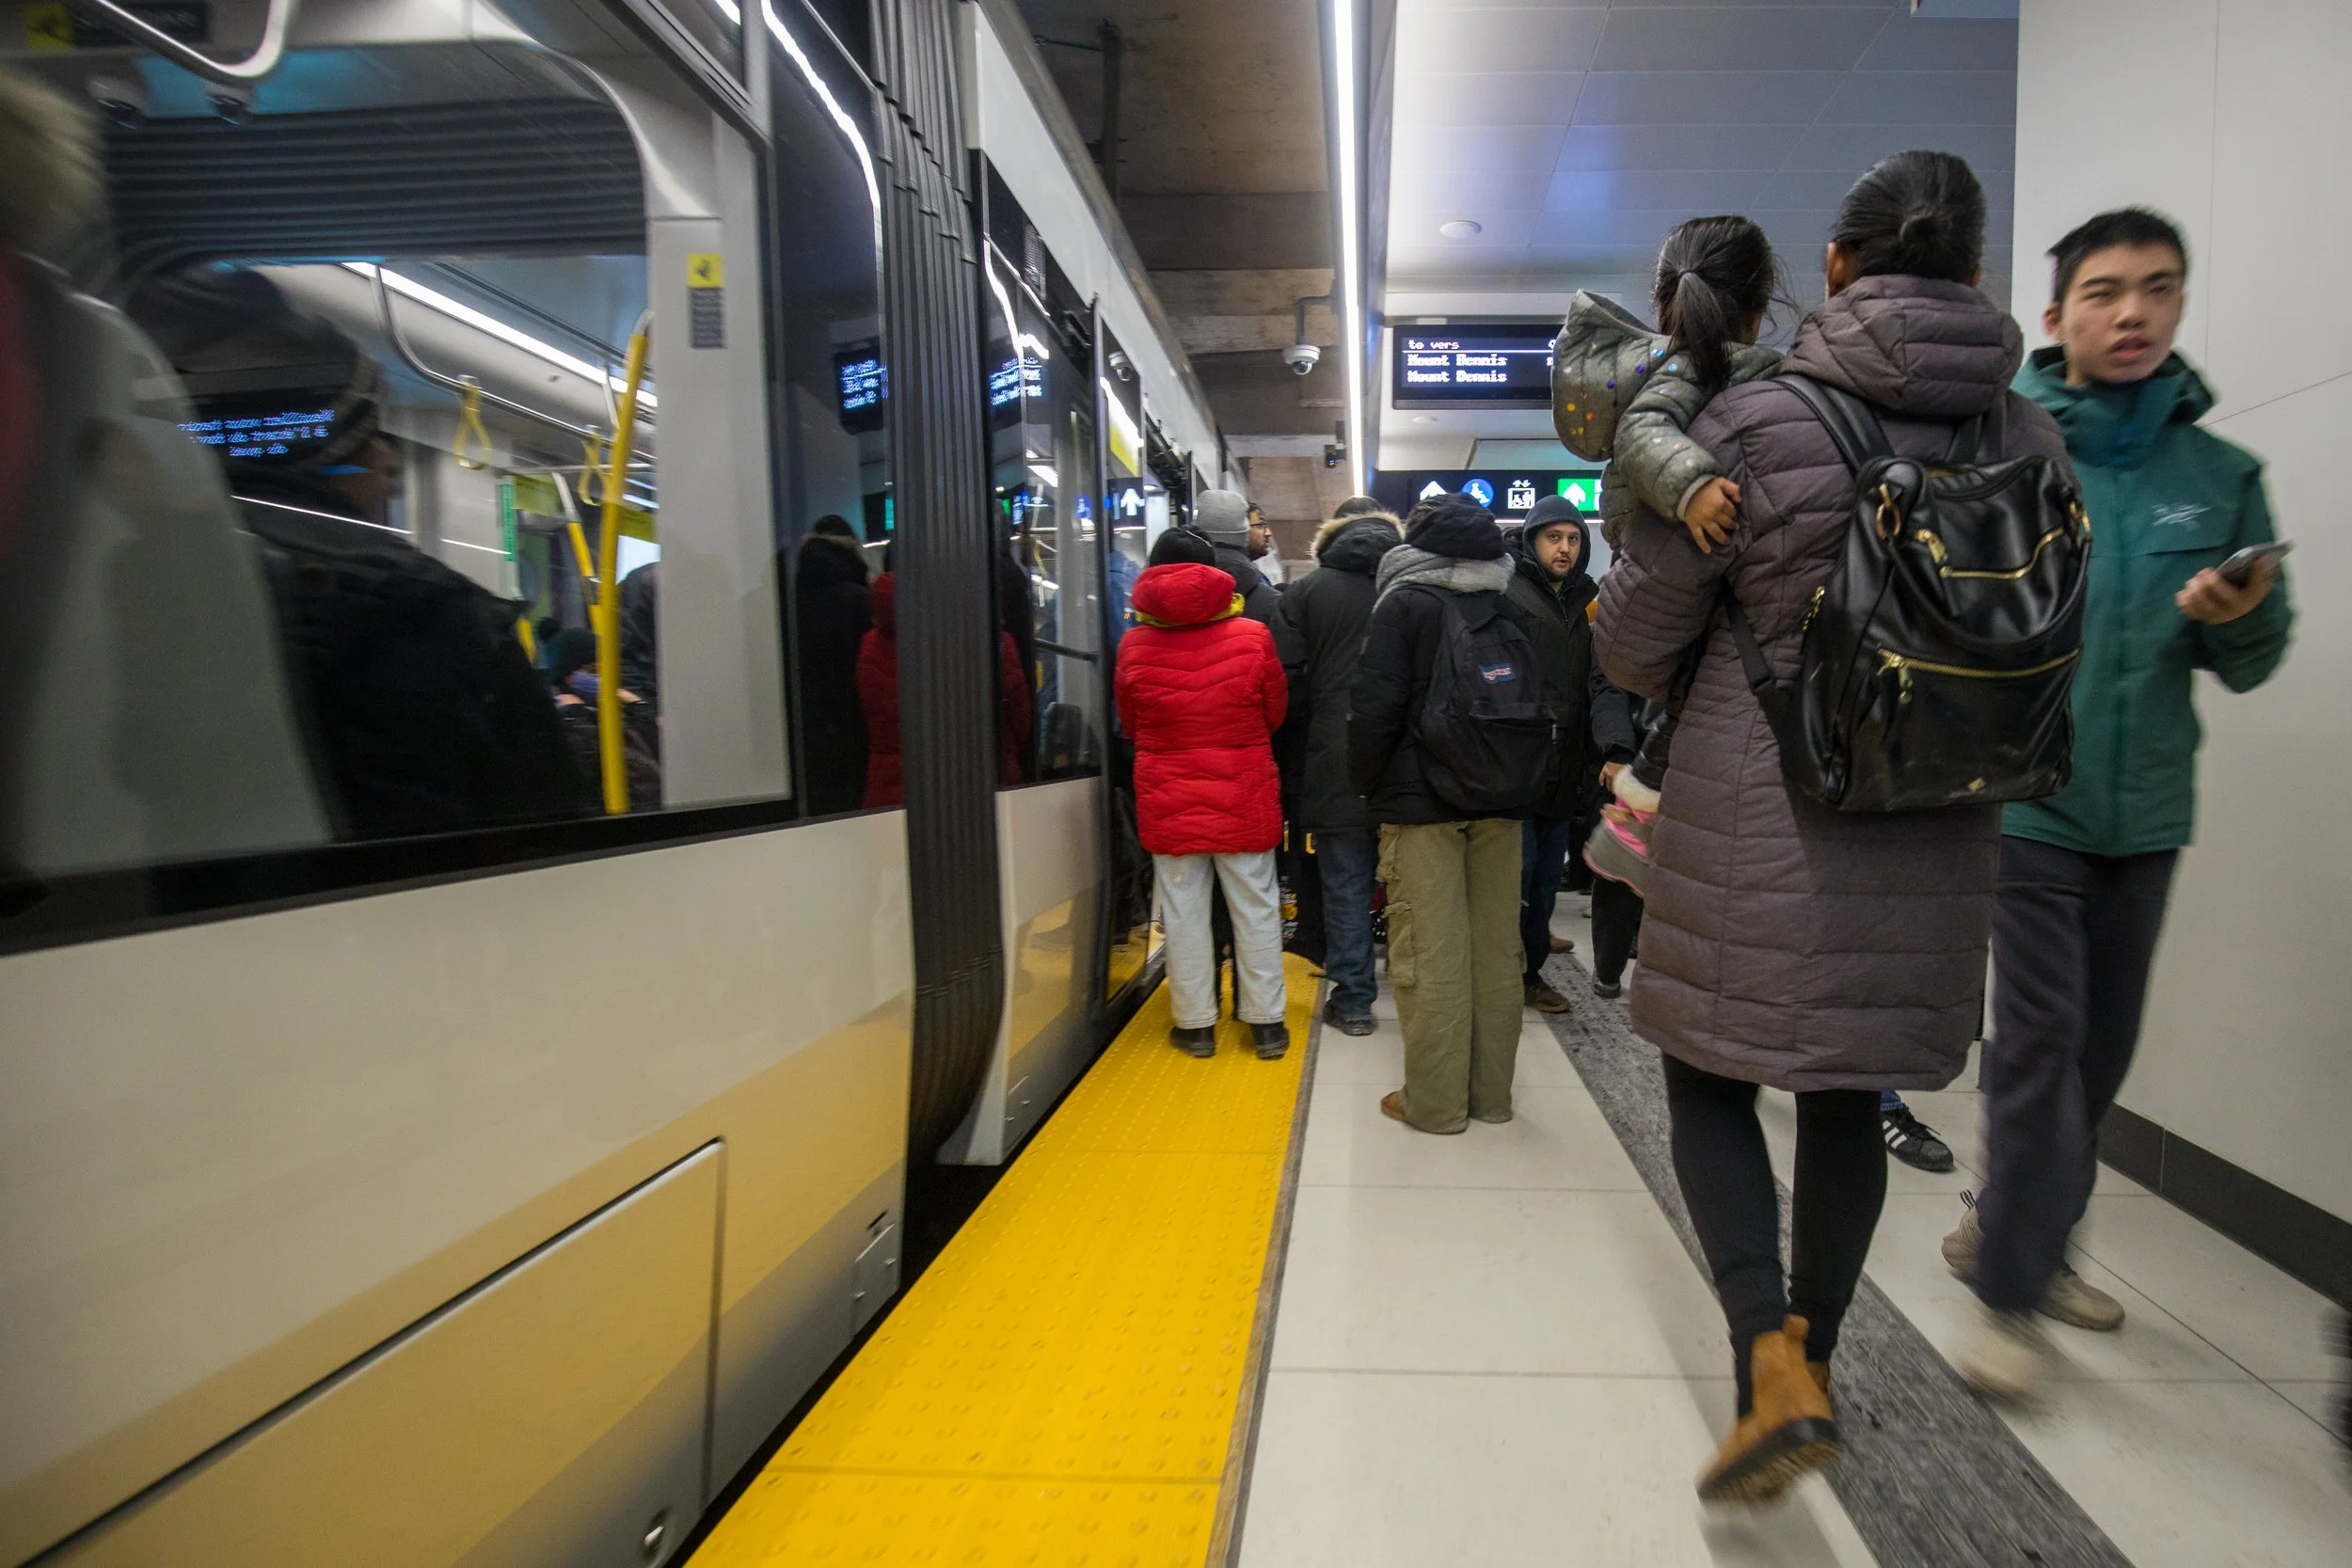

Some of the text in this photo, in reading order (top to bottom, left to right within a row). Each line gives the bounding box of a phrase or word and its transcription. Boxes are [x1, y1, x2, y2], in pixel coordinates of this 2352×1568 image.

[1408, 340, 1460, 350] to vers
[1407, 371, 1507, 382] Mount Dennis
